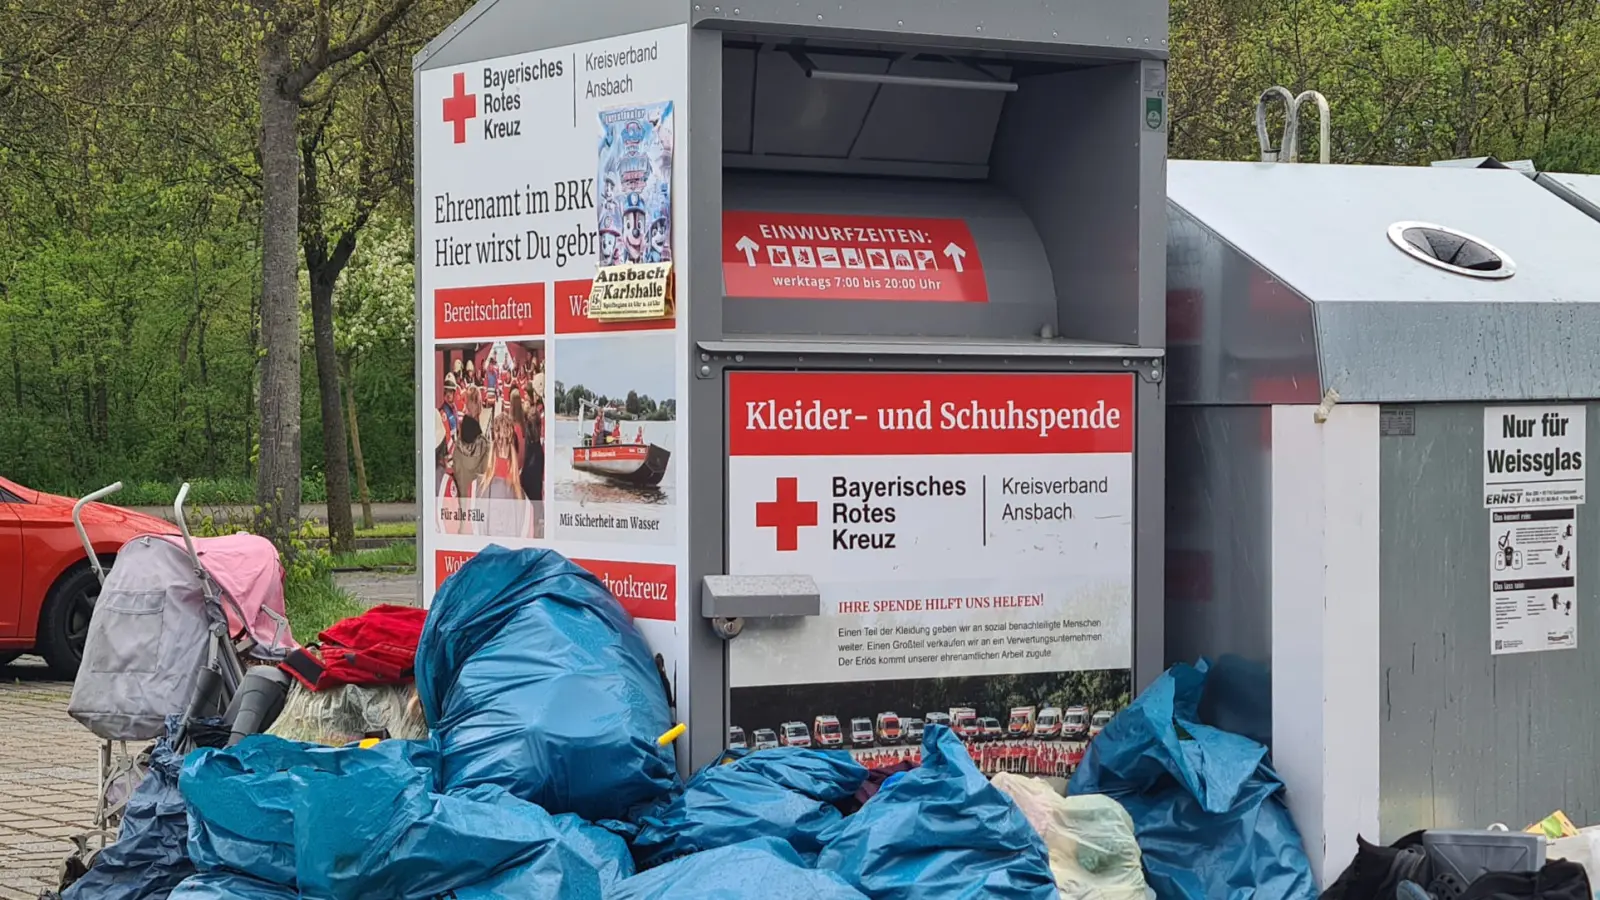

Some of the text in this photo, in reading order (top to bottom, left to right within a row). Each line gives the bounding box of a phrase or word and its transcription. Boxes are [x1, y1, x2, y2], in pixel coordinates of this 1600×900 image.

[585, 41, 658, 72] Kreisverband
[483, 58, 564, 91] Bayerisches
[585, 73, 633, 100] Ansbach
[484, 90, 521, 115] Rotes
[484, 119, 521, 141] Kreuz
[435, 178, 594, 225] Ehrenamt im BRK
[759, 223, 932, 244] EINWURFZEITEN:
[435, 237, 472, 267] Hier
[475, 231, 521, 264] wirst
[526, 230, 550, 260] Du
[595, 267, 665, 283] Ansbach
[772, 275, 941, 290] werktags 7:00 bis 20:00 Uhr
[603, 282, 663, 300] Karlshalle
[443, 296, 532, 324] Bereitschaften
[745, 400, 1121, 438] Kleider- und Schuhspende
[1502, 412, 1569, 438] Nur für
[1487, 447, 1582, 477] Weissglas
[832, 476, 967, 503] Bayerisches
[1002, 476, 1108, 496] Kreisverband
[1486, 492, 1523, 505] ERNST
[440, 508, 485, 522] Für alle Fälle
[559, 513, 660, 530] Mit Sicherheit am Wasser
[832, 503, 896, 523] Rotes
[1002, 502, 1073, 521] Ansbach
[832, 531, 896, 550] Kreuz
[838, 593, 1044, 613] IHRE SPENDE HILFT UNS HELFEN!
[838, 627, 862, 637] Einen
[864, 627, 878, 636] Teil
[880, 626, 893, 635] der
[895, 625, 930, 636] Kleidung
[932, 624, 957, 636] geben
[972, 624, 983, 632] an
[984, 621, 1007, 631] sozial
[1008, 619, 1061, 631] benachteiligte
[1062, 618, 1102, 629] Menschen
[838, 632, 1103, 652] weiter. Einen Großteil verkaufen wir an ein Verwertungsunternehmen
[838, 648, 1052, 666] Der Erlös kommt unserer ehrenamtlichen Arbeit zugute
